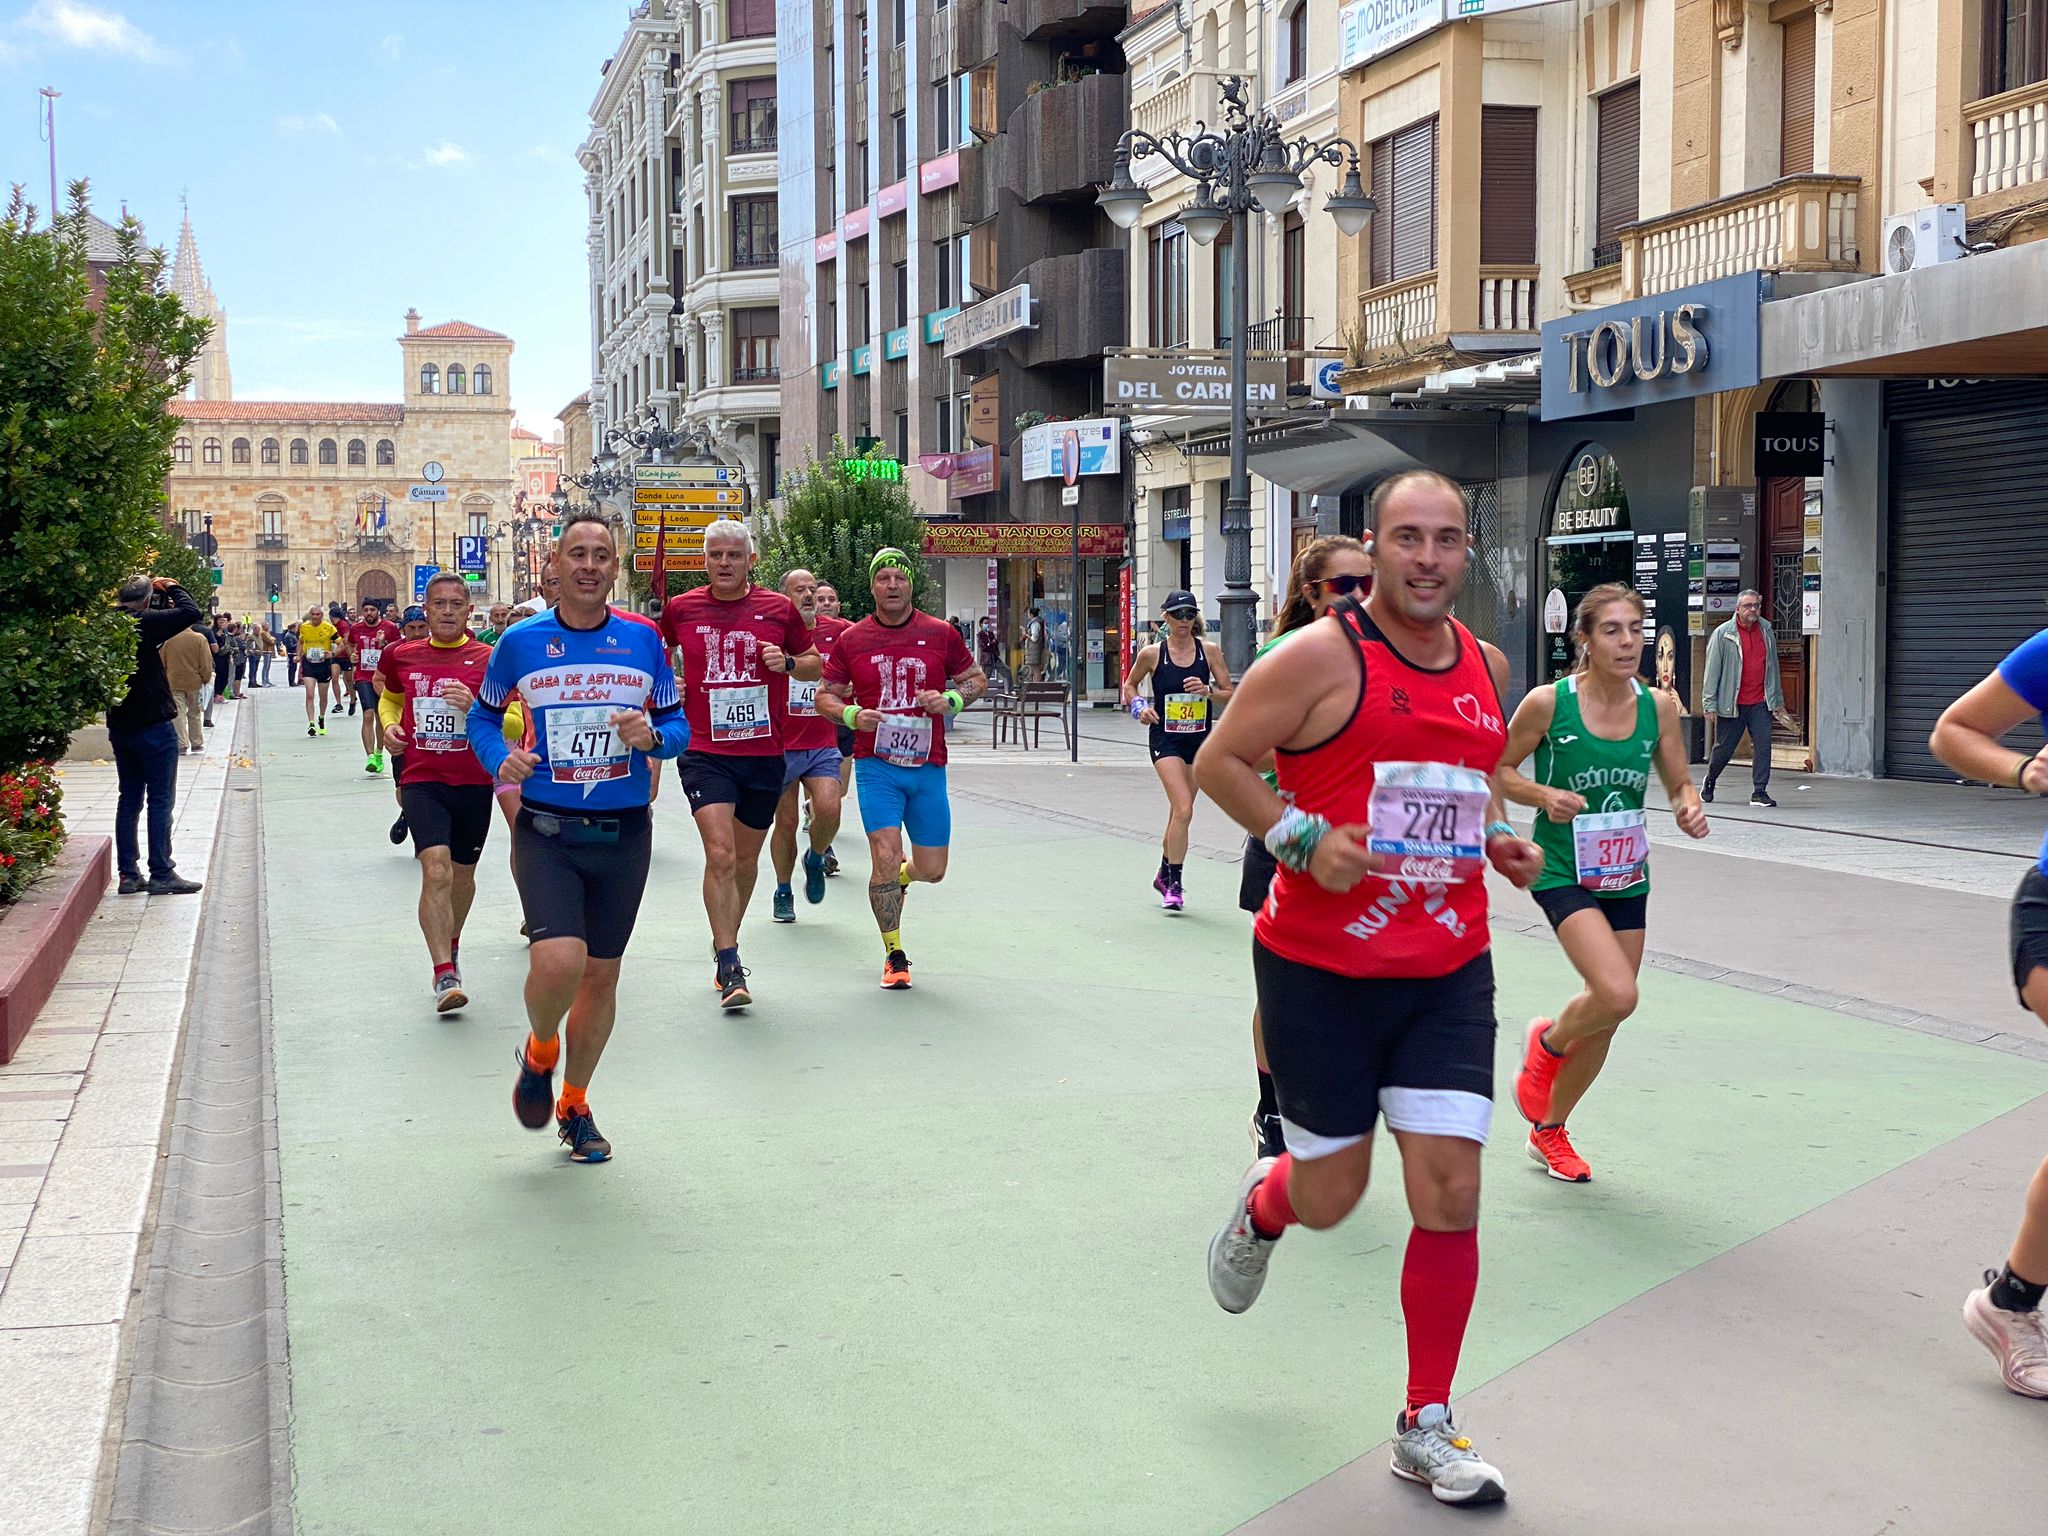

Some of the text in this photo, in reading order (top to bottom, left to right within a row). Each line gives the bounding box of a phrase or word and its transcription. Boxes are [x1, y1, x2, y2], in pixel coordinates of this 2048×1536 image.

[1560, 304, 1709, 393] TOUS
[1168, 365, 1227, 376] JOYERIA
[1118, 381, 1276, 400] DEL CAREN
[1762, 437, 1820, 452] TOUS
[1580, 466, 1594, 486] BE
[637, 492, 662, 500] Conde
[637, 513, 653, 521] Luis
[670, 514, 689, 522] León
[1164, 507, 1191, 521] ESTRELLA
[1559, 507, 1619, 530] BE BEAUTY
[926, 526, 1100, 537] ROYAL TANDOORI
[530, 672, 643, 689] CASA DE ASTURIAS
[559, 686, 611, 701] LEÓN
[726, 703, 756, 723] 469
[1180, 706, 1194, 719] 34
[425, 714, 455, 733] 539
[571, 731, 611, 758] 477
[890, 731, 919, 751] 342
[1402, 802, 1458, 841] 270
[1598, 837, 1636, 867] 372
